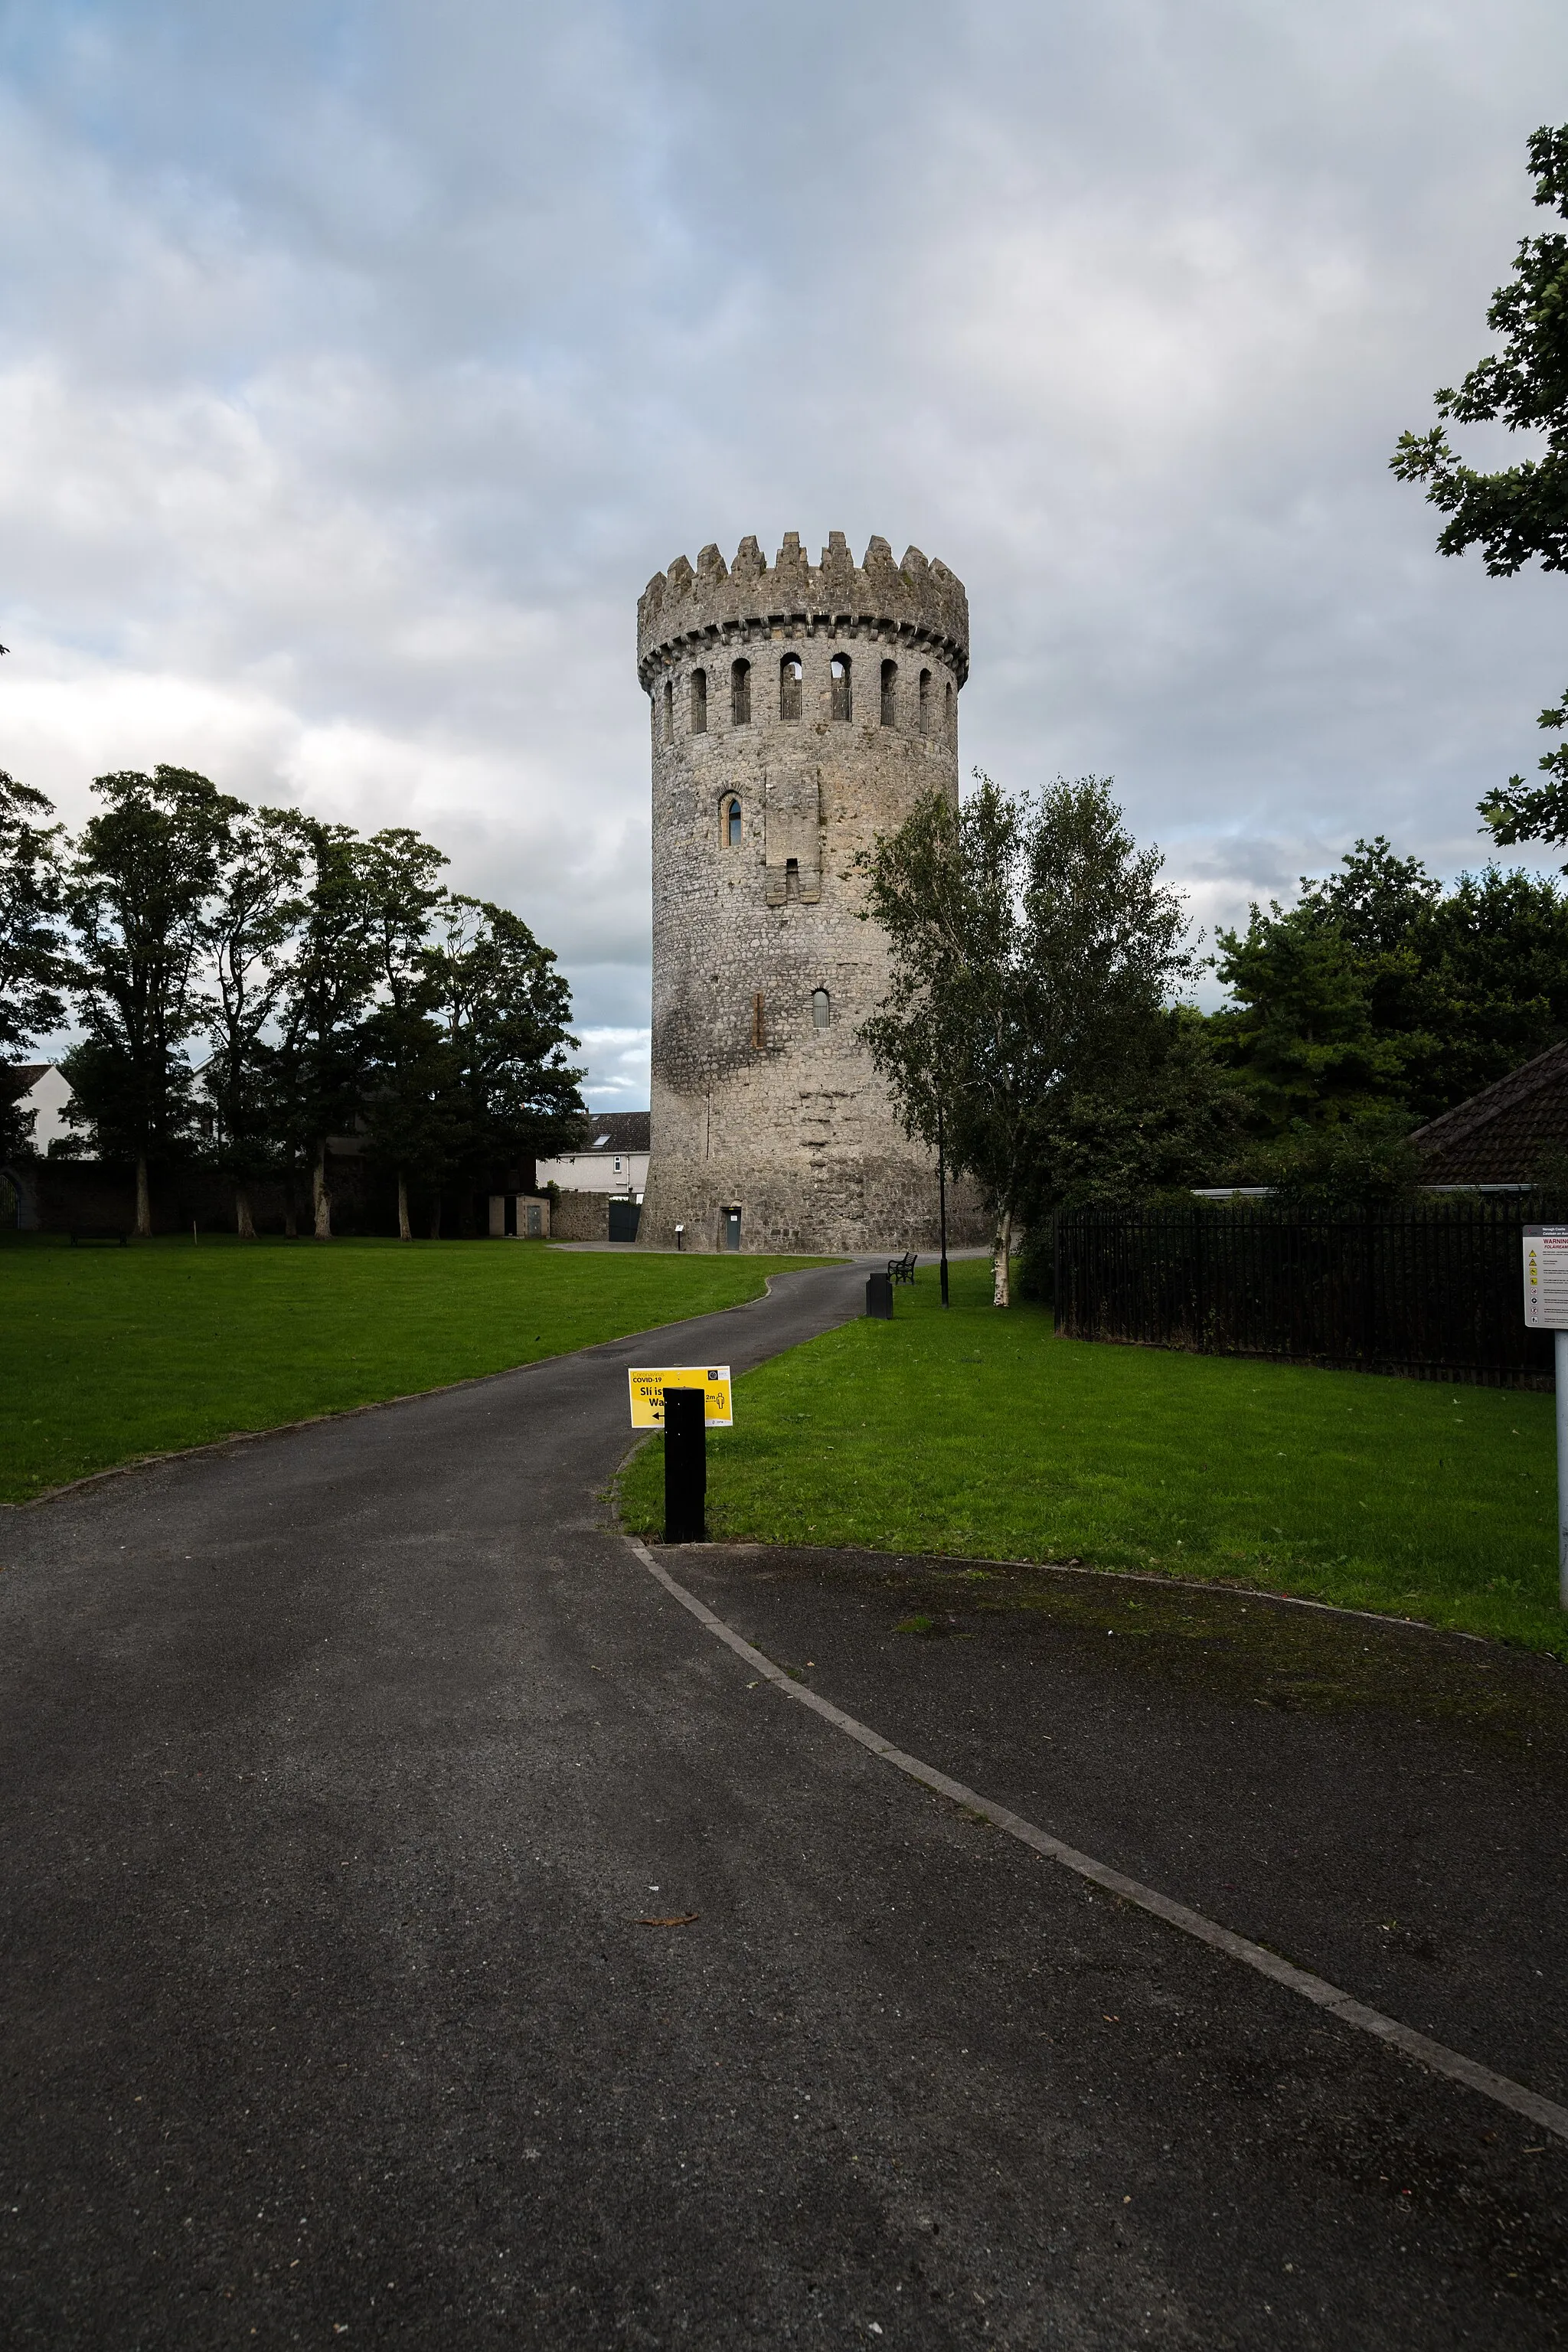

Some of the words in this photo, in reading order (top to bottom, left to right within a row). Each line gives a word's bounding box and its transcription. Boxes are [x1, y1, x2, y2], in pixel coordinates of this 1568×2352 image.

[640, 1387, 652, 1396] Slí
[655, 1387, 663, 1396] is
[648, 1398, 664, 1406] Wa
